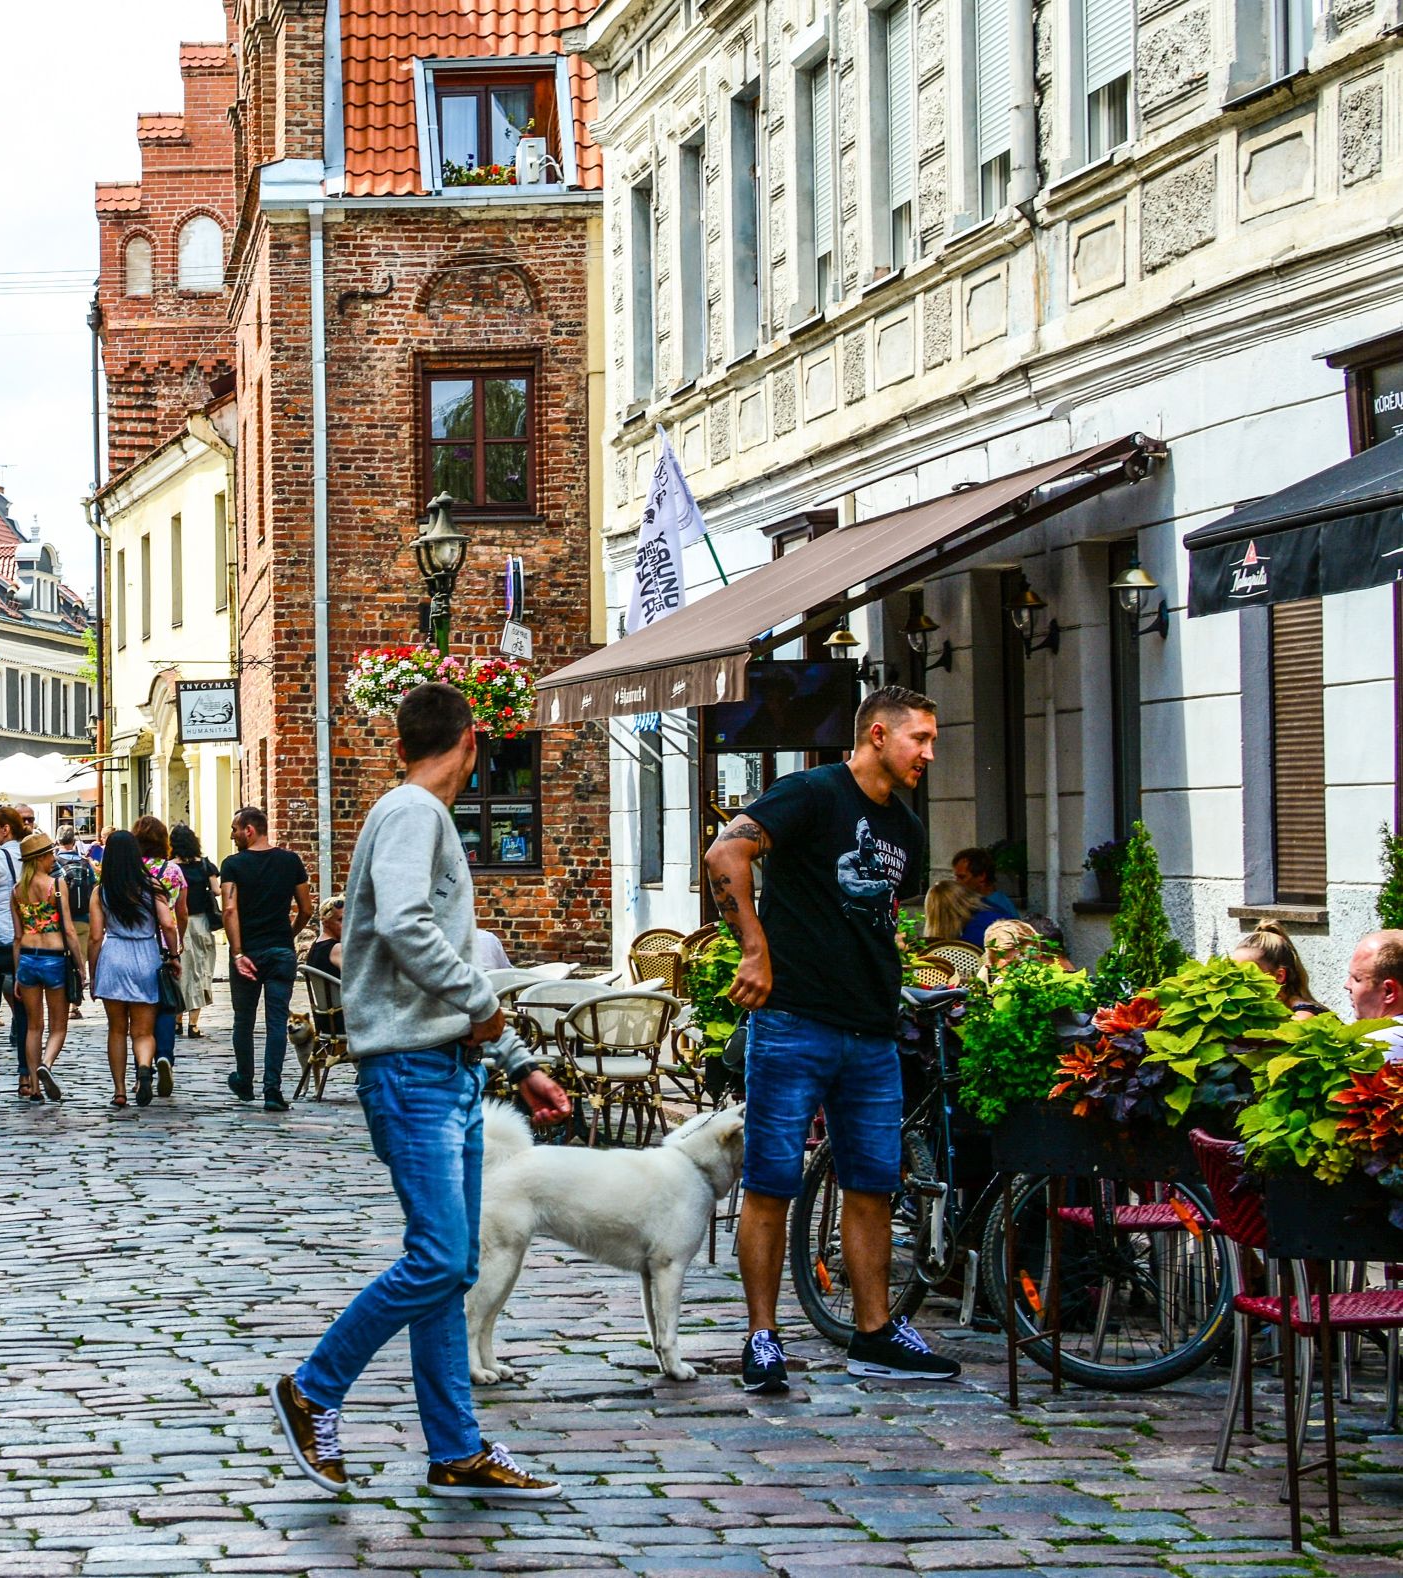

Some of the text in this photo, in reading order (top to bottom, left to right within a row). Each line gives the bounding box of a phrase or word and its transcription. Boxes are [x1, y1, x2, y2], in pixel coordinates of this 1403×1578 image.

[179, 681, 235, 690] KNYGYNAS
[186, 727, 232, 735] HUMANITAS
[875, 839, 906, 862] AKLAND
